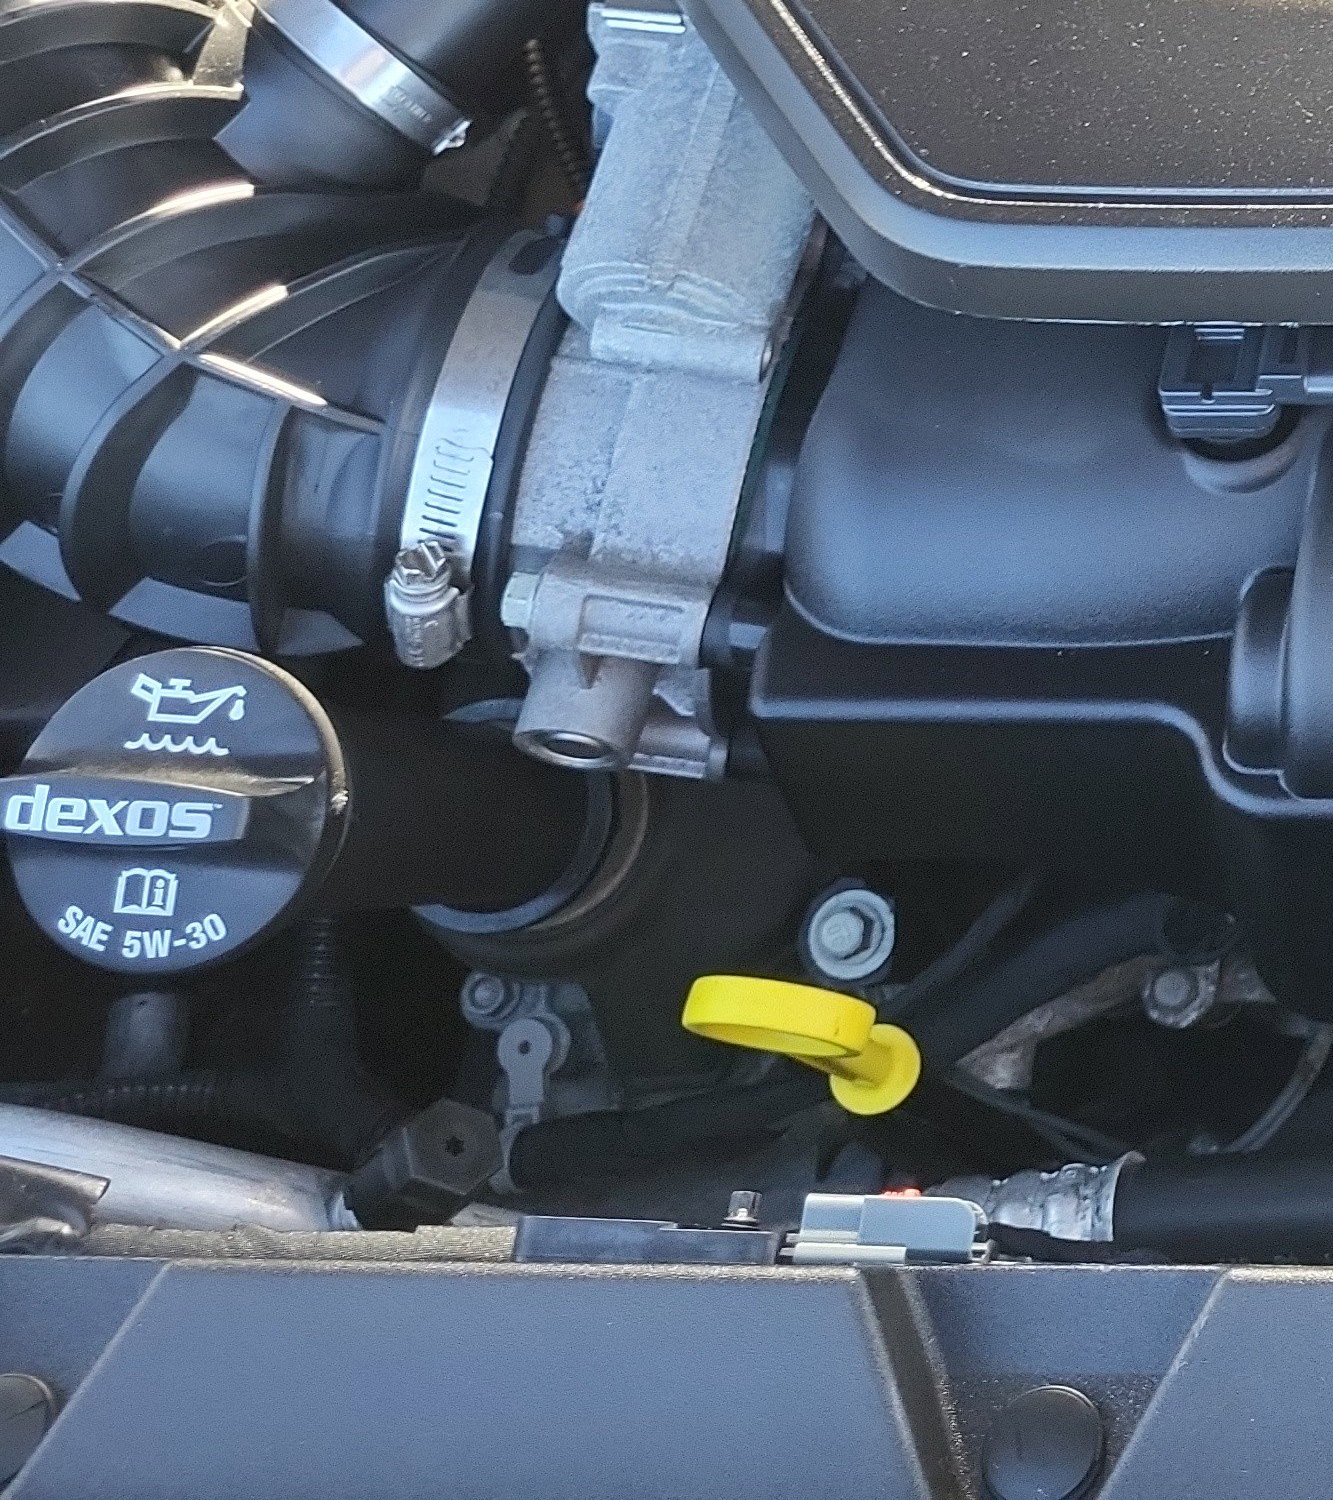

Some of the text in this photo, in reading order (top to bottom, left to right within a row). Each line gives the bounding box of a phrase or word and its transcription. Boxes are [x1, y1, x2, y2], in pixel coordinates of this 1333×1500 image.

[4, 784, 217, 838] dexos
[57, 905, 227, 959] SAE 5W-30
